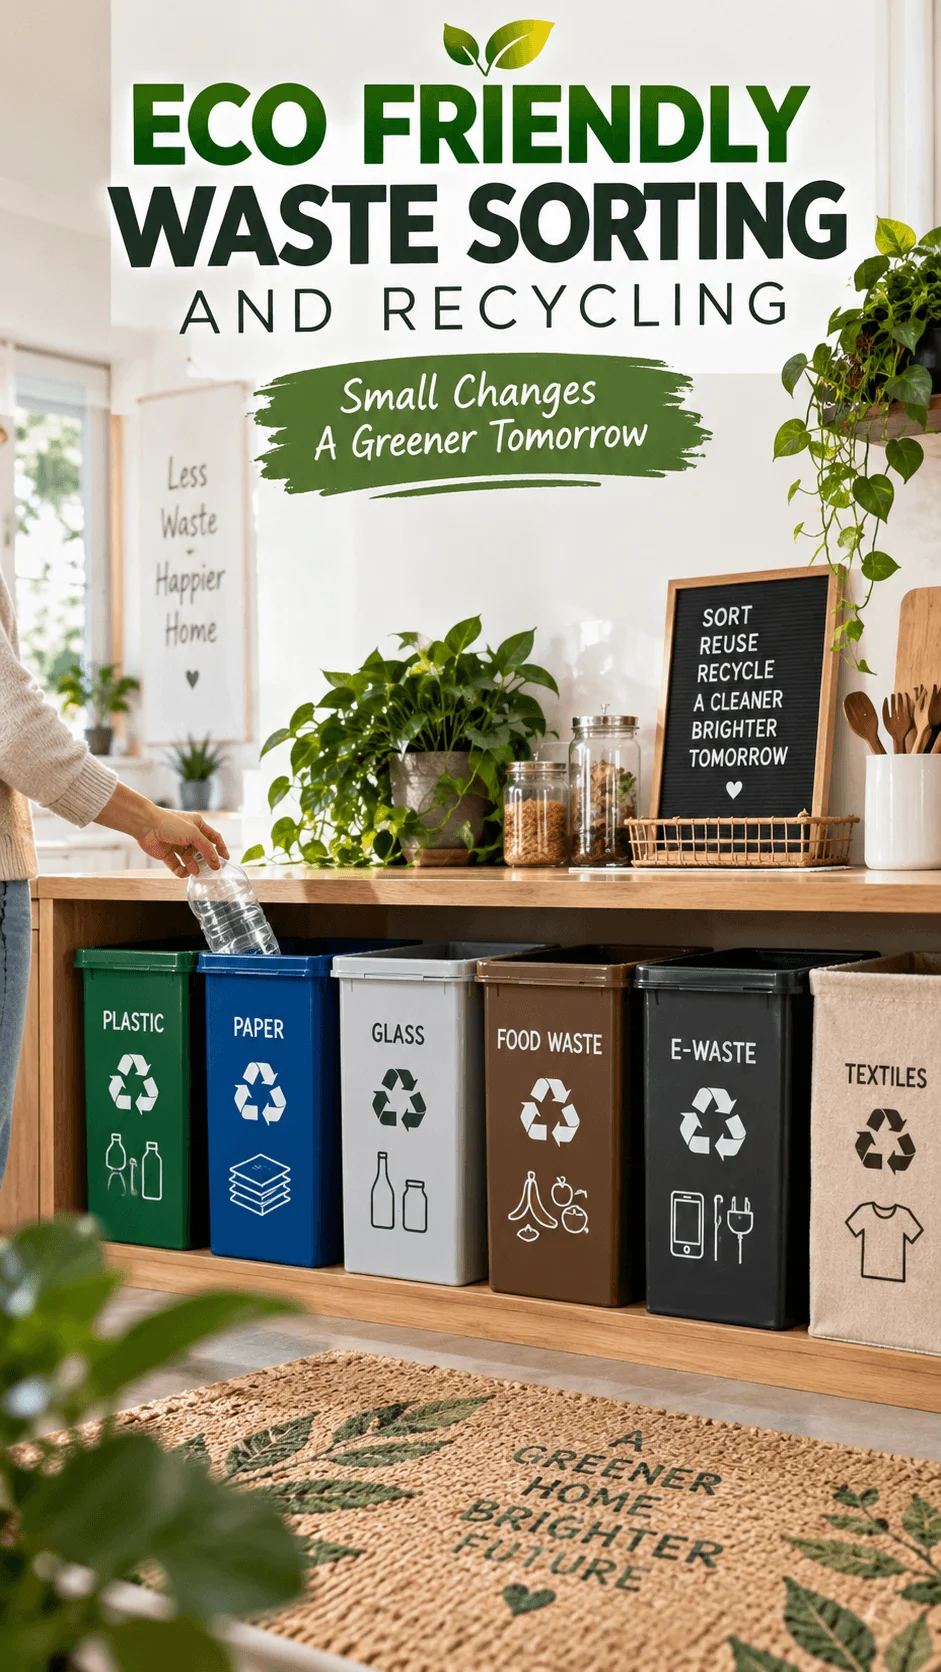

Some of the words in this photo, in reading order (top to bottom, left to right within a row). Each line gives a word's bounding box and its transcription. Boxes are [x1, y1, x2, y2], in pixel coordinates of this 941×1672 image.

[168, 454, 207, 490] Less
[161, 503, 217, 540] Waste
[155, 559, 225, 604] Happier
[165, 610, 217, 646] Home
[702, 605, 753, 628] SORT
[700, 633, 759, 655] REUSE
[697, 660, 775, 683] RECYCLE
[693, 693, 704, 712] A
[710, 690, 783, 711] CLEANER
[691, 719, 777, 740] BRIGHTER
[689, 746, 789, 768] TOMORROW
[103, 1010, 165, 1034] PLASTIC
[233, 1016, 284, 1040] PAPER
[371, 1022, 425, 1046] GLASS
[497, 1028, 541, 1052] FOOD
[547, 1031, 602, 1056] WASTE
[671, 1038, 757, 1064] E-WASTE
[845, 1063, 927, 1089] TEXTILES
[608, 1429, 643, 1452] A
[513, 1445, 722, 1495] GREENER
[520, 1476, 662, 1518] HOME
[459, 1500, 724, 1568] BRIGHTER
[452, 1533, 651, 1592] FUTURE
